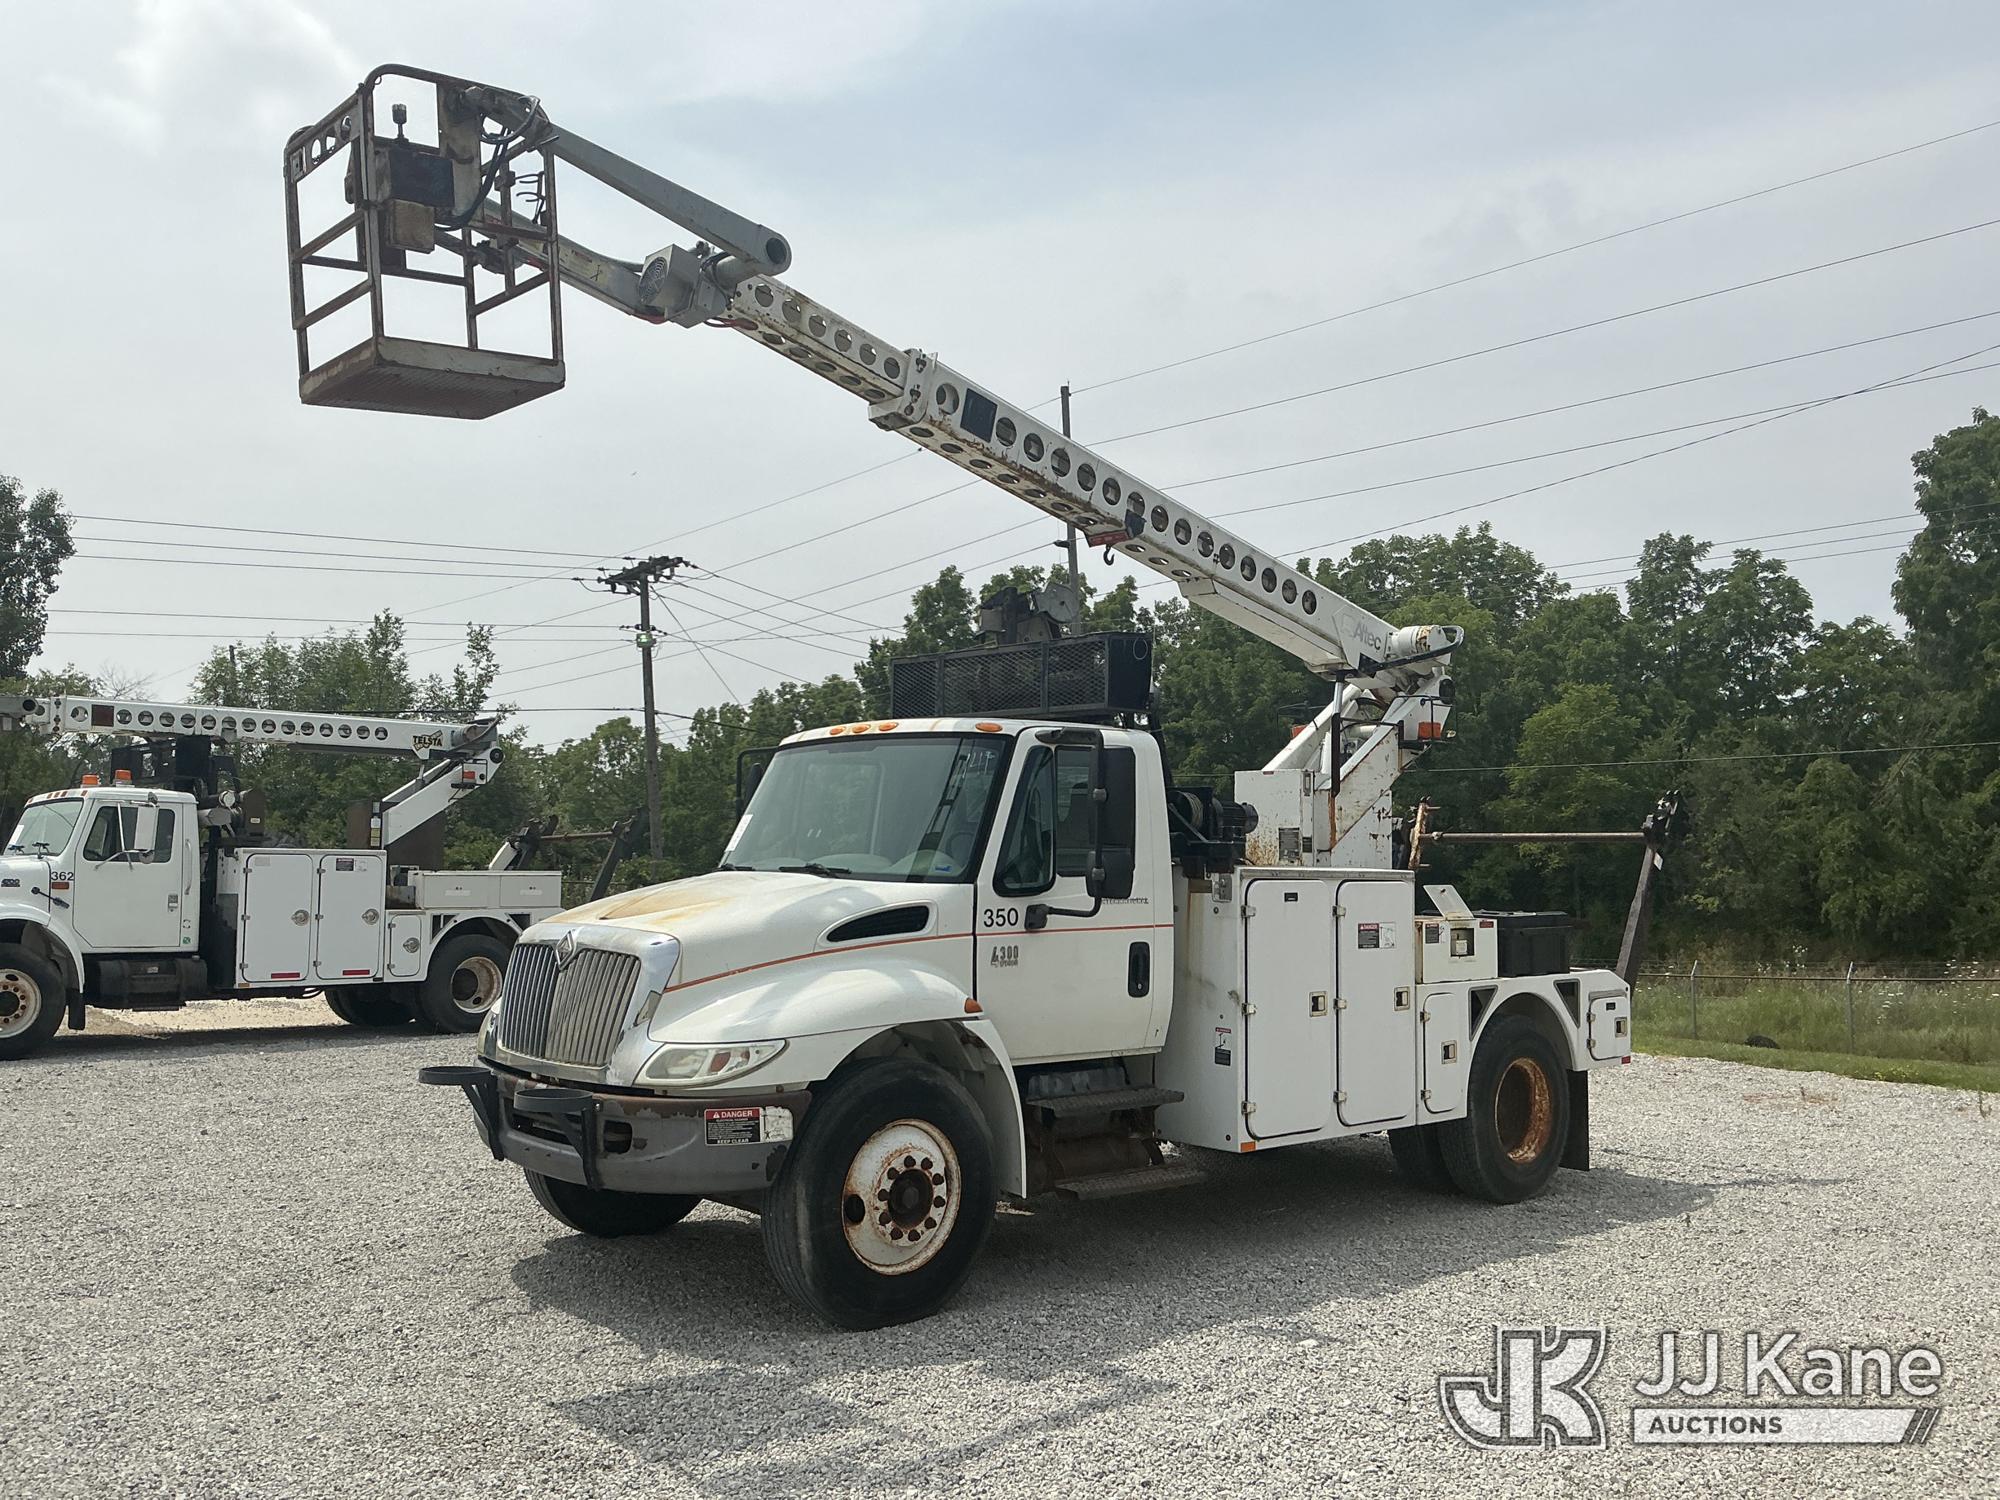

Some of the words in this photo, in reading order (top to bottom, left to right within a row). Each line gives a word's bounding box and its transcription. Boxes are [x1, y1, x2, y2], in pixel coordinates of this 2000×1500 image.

[412, 735, 443, 747] TELSTA
[50, 871, 75, 881] 362
[983, 907, 1019, 928] 350
[990, 945, 1019, 964] 4300
[720, 1110, 753, 1118] DANGER
